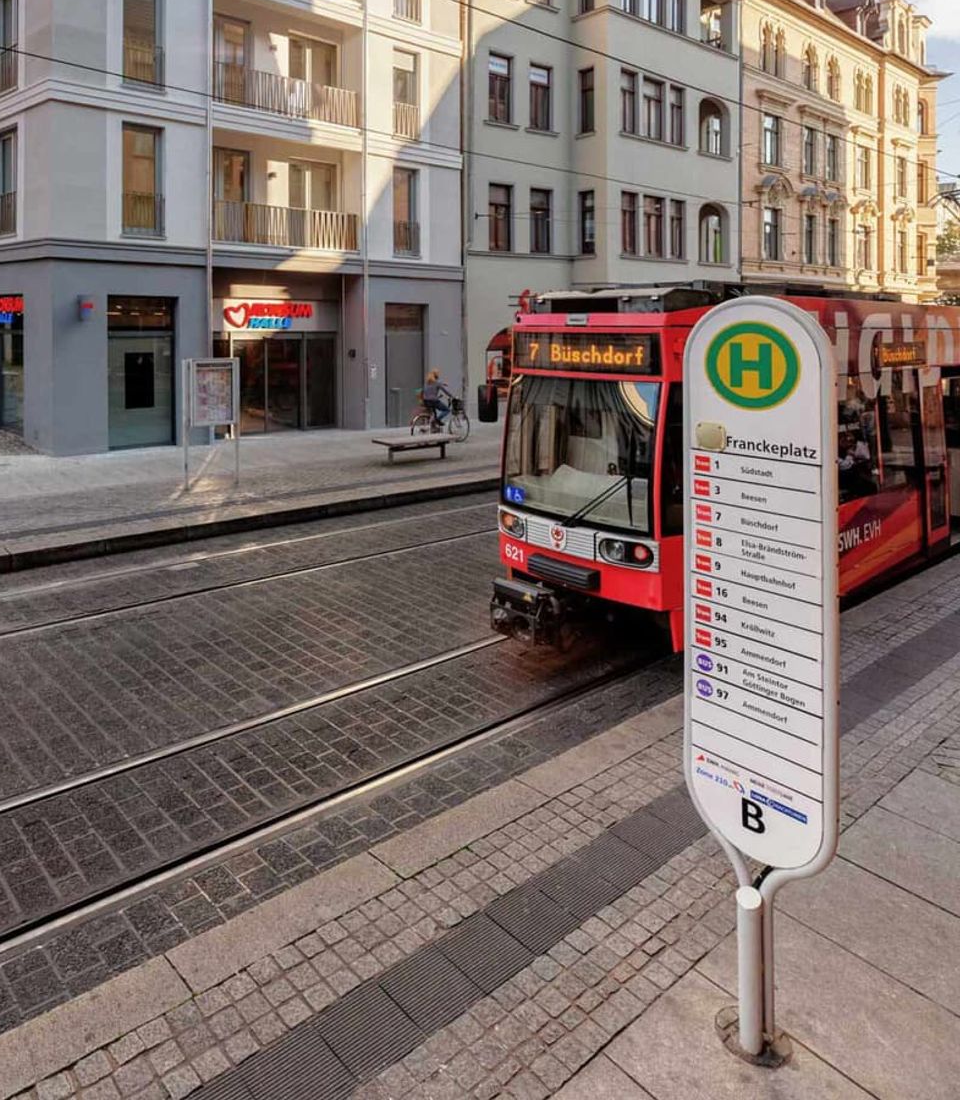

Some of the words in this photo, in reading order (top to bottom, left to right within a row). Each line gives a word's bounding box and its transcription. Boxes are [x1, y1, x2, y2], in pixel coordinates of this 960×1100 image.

[529, 342, 539, 361] 7
[550, 343, 644, 366] Büschdorf
[729, 342, 772, 390] H
[725, 435, 818, 460] Franckeplatz
[715, 460, 720, 470] 1
[740, 466, 774, 478] Südstadt
[714, 485, 721, 495] 3
[741, 492, 767, 504] Beesen
[715, 511, 722, 521] 7
[740, 517, 779, 532] Büschdorf
[863, 519, 881, 542] EVH
[505, 543, 524, 563] 621
[715, 536, 723, 548] 8
[741, 539, 807, 560] Elsa-Brändström-
[741, 548, 766, 560] Straße
[714, 561, 721, 571] 9
[741, 569, 796, 590] Hauptbahnhof
[716, 586, 728, 598] 16
[742, 596, 768, 610] Beesen
[714, 611, 727, 623] 94
[741, 621, 775, 638] Kröllwitz
[714, 636, 727, 648] 95
[741, 648, 786, 669] Ammendorf
[716, 663, 728, 675] 91
[742, 668, 756, 680] Am
[757, 673, 789, 690] Steintor
[742, 679, 778, 698] Göttinger
[780, 691, 806, 708] Bogen
[716, 688, 729, 700] 97
[742, 700, 788, 724] Ammendorf
[741, 796, 766, 835] B
